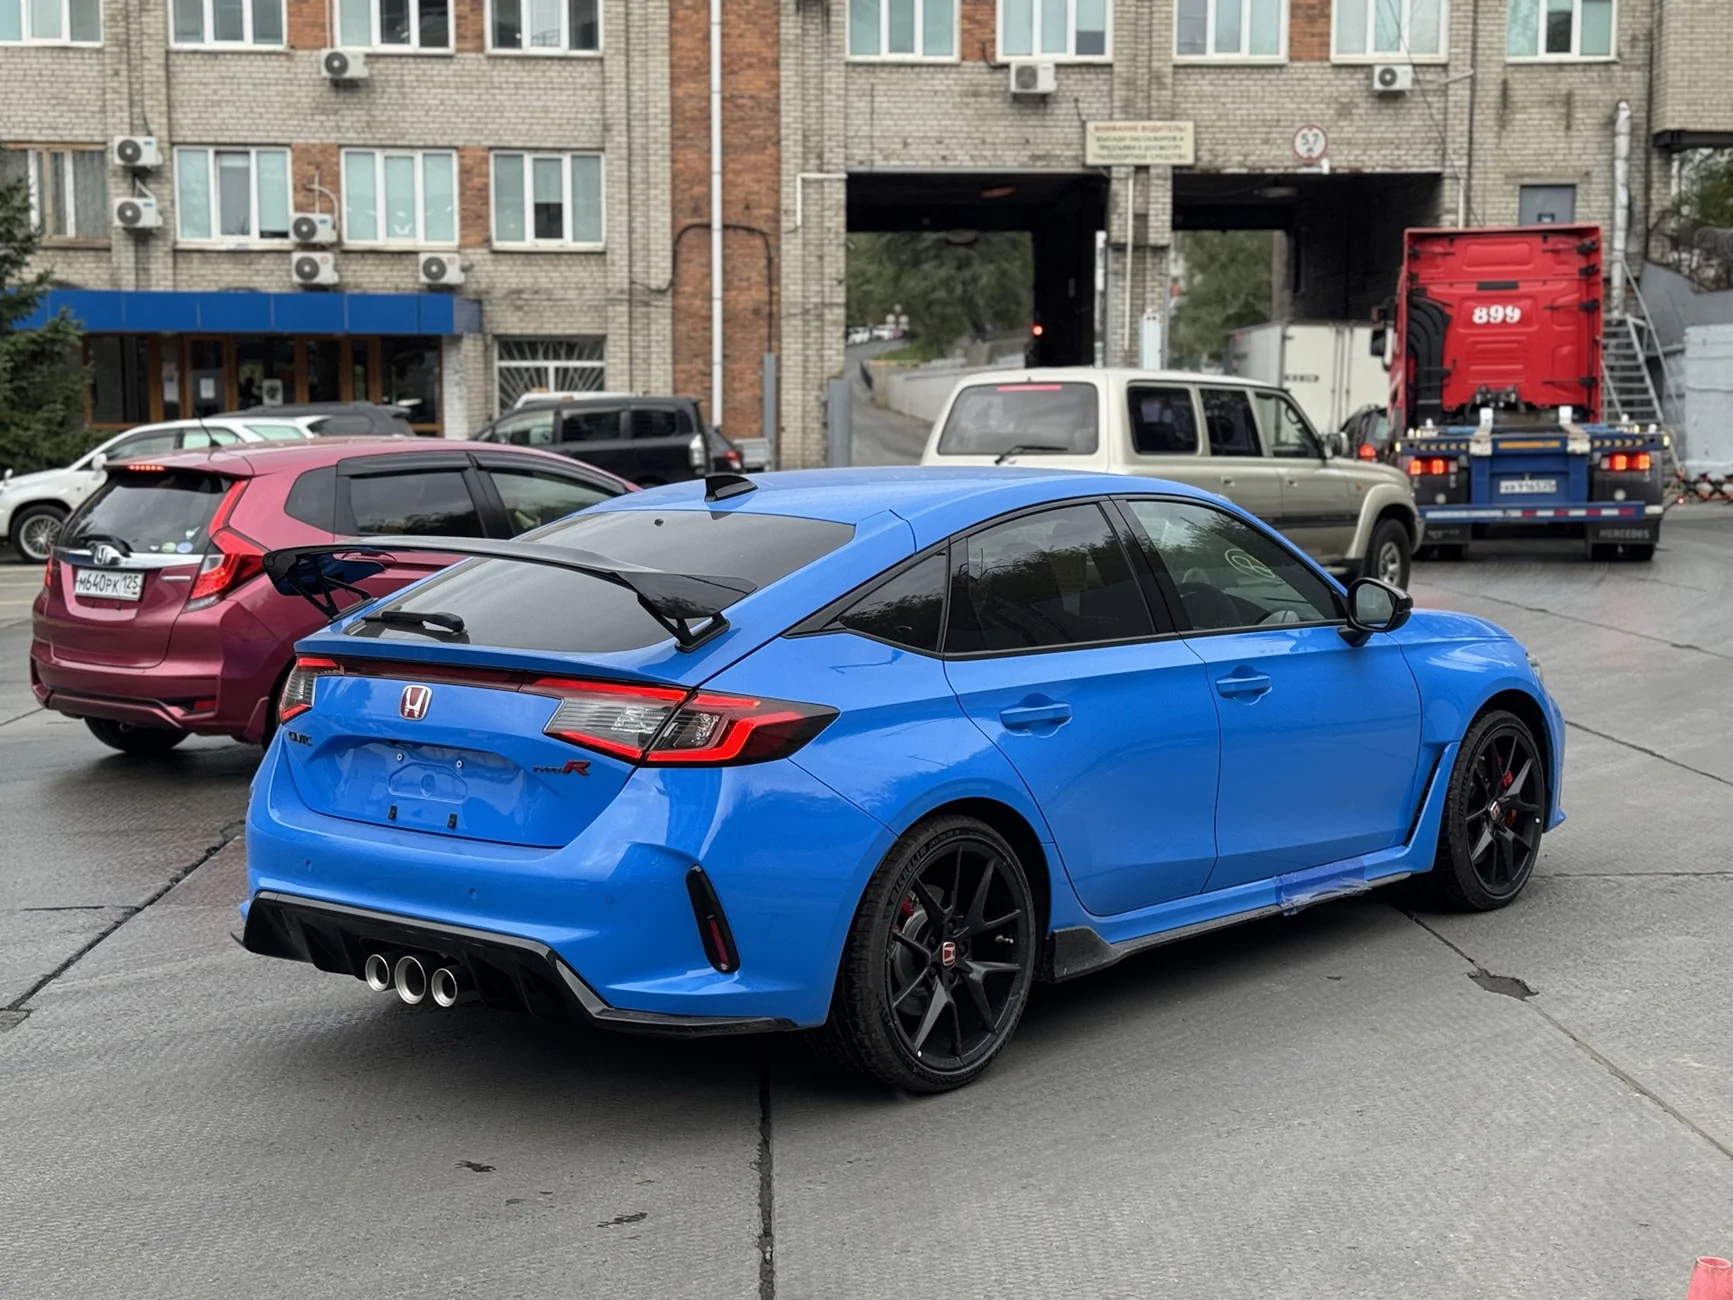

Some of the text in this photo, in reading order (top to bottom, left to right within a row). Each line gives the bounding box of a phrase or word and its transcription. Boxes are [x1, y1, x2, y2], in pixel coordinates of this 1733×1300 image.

[1472, 304, 1522, 324] 899
[78, 573, 138, 593] М640РК 125
